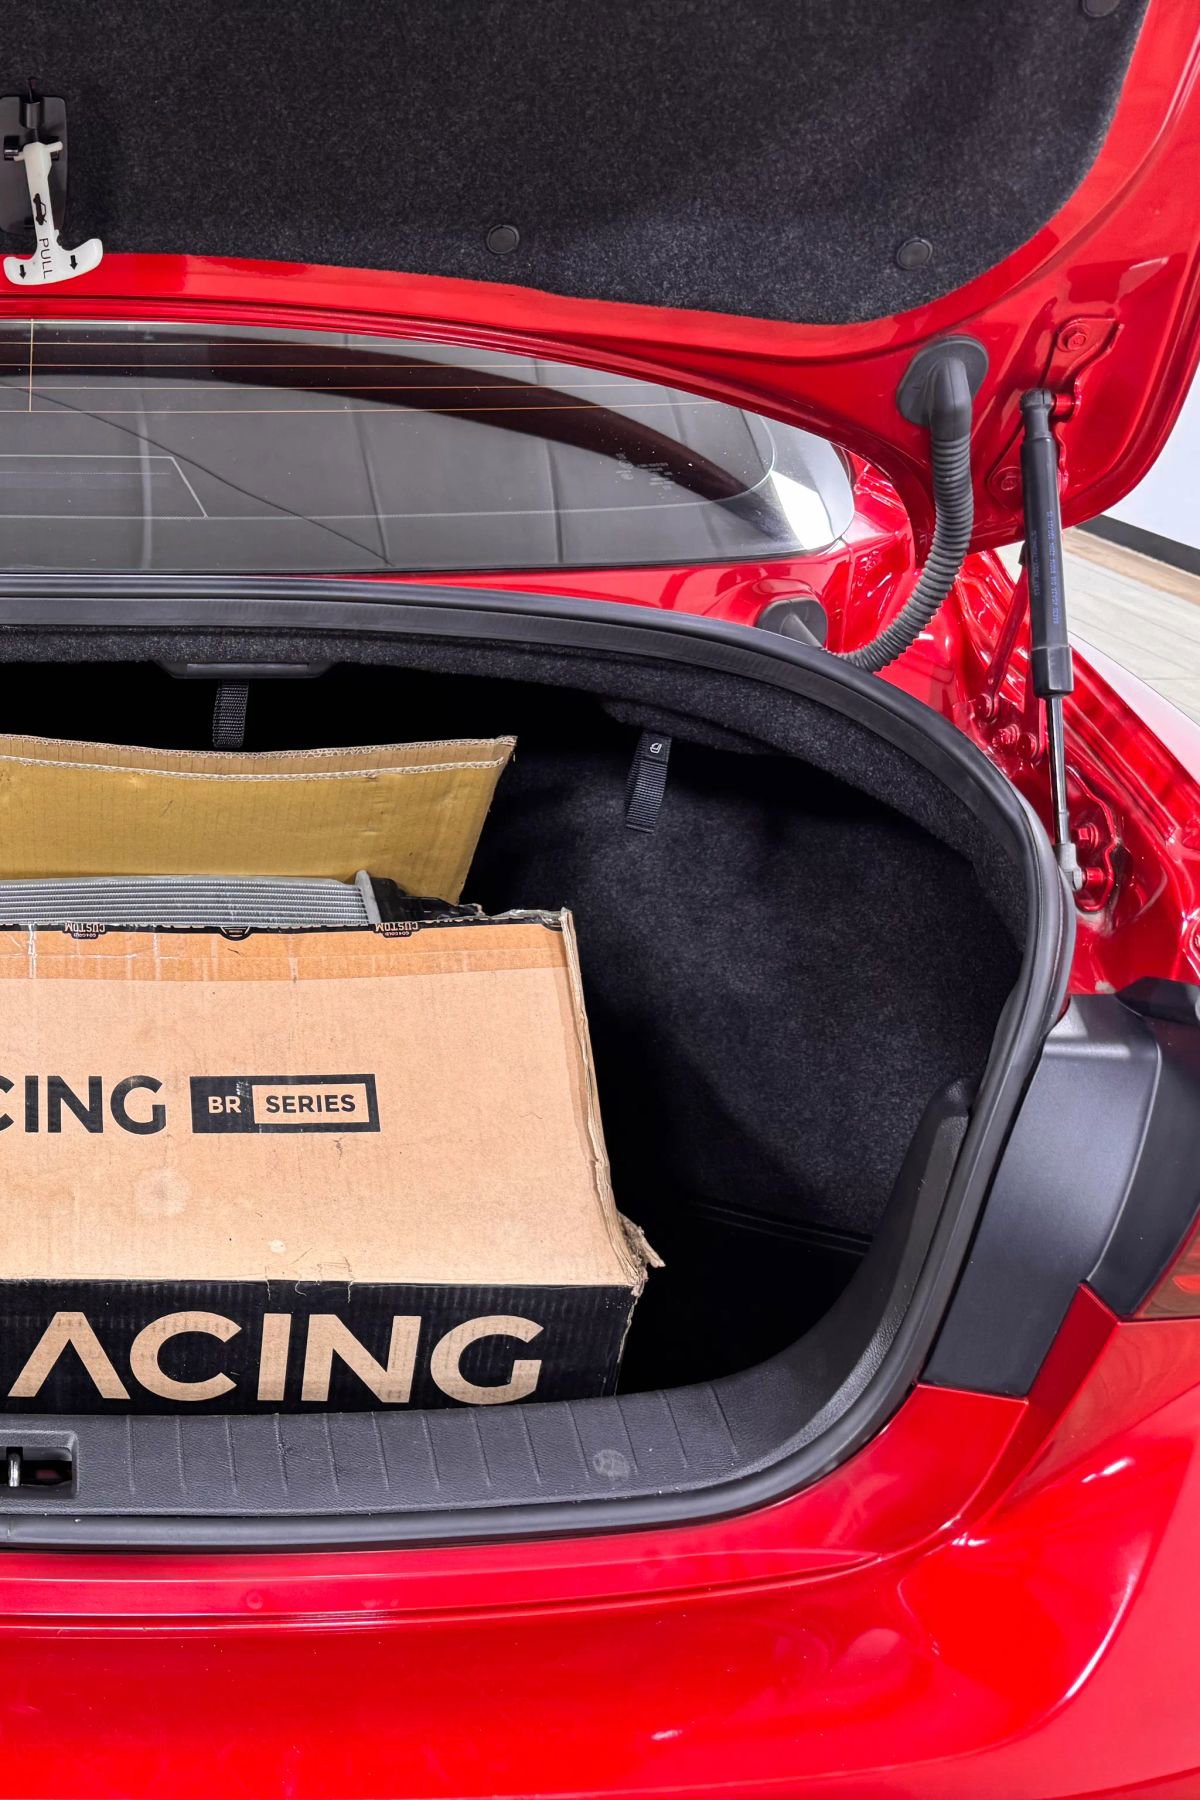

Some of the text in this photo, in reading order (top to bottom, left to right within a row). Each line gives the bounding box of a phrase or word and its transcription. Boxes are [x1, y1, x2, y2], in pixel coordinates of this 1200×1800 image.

[39, 237, 53, 279] PULL
[64, 921, 106, 932] CUSTOM
[375, 921, 418, 931] CUSTOM
[207, 1094, 356, 1114] BR SERIES
